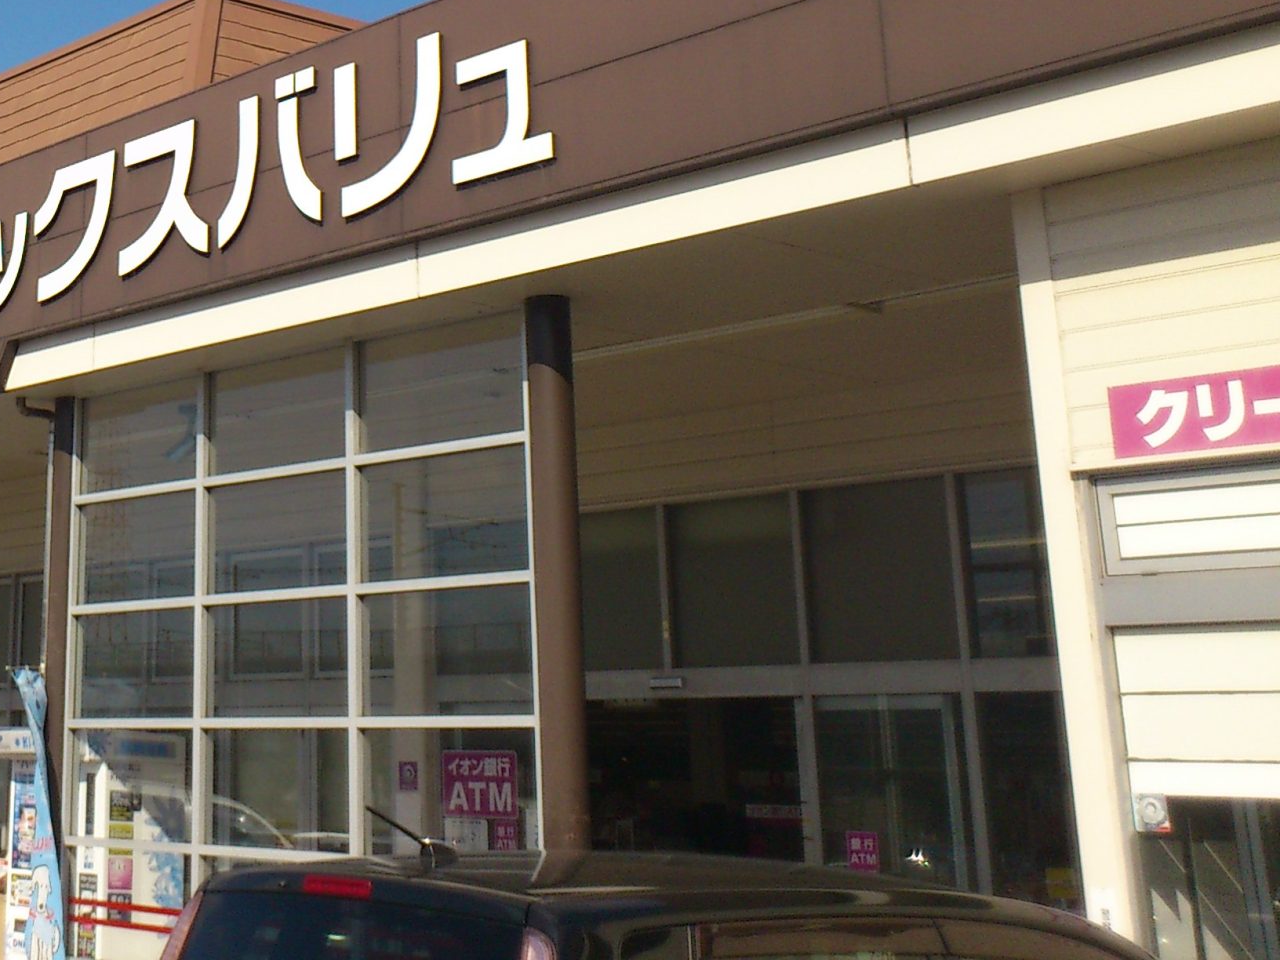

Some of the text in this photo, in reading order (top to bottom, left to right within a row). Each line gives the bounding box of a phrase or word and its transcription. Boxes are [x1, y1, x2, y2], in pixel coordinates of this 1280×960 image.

[448, 756, 511, 777] イオン銀行
[449, 781, 513, 812] ATM
[850, 853, 877, 865] ATM
